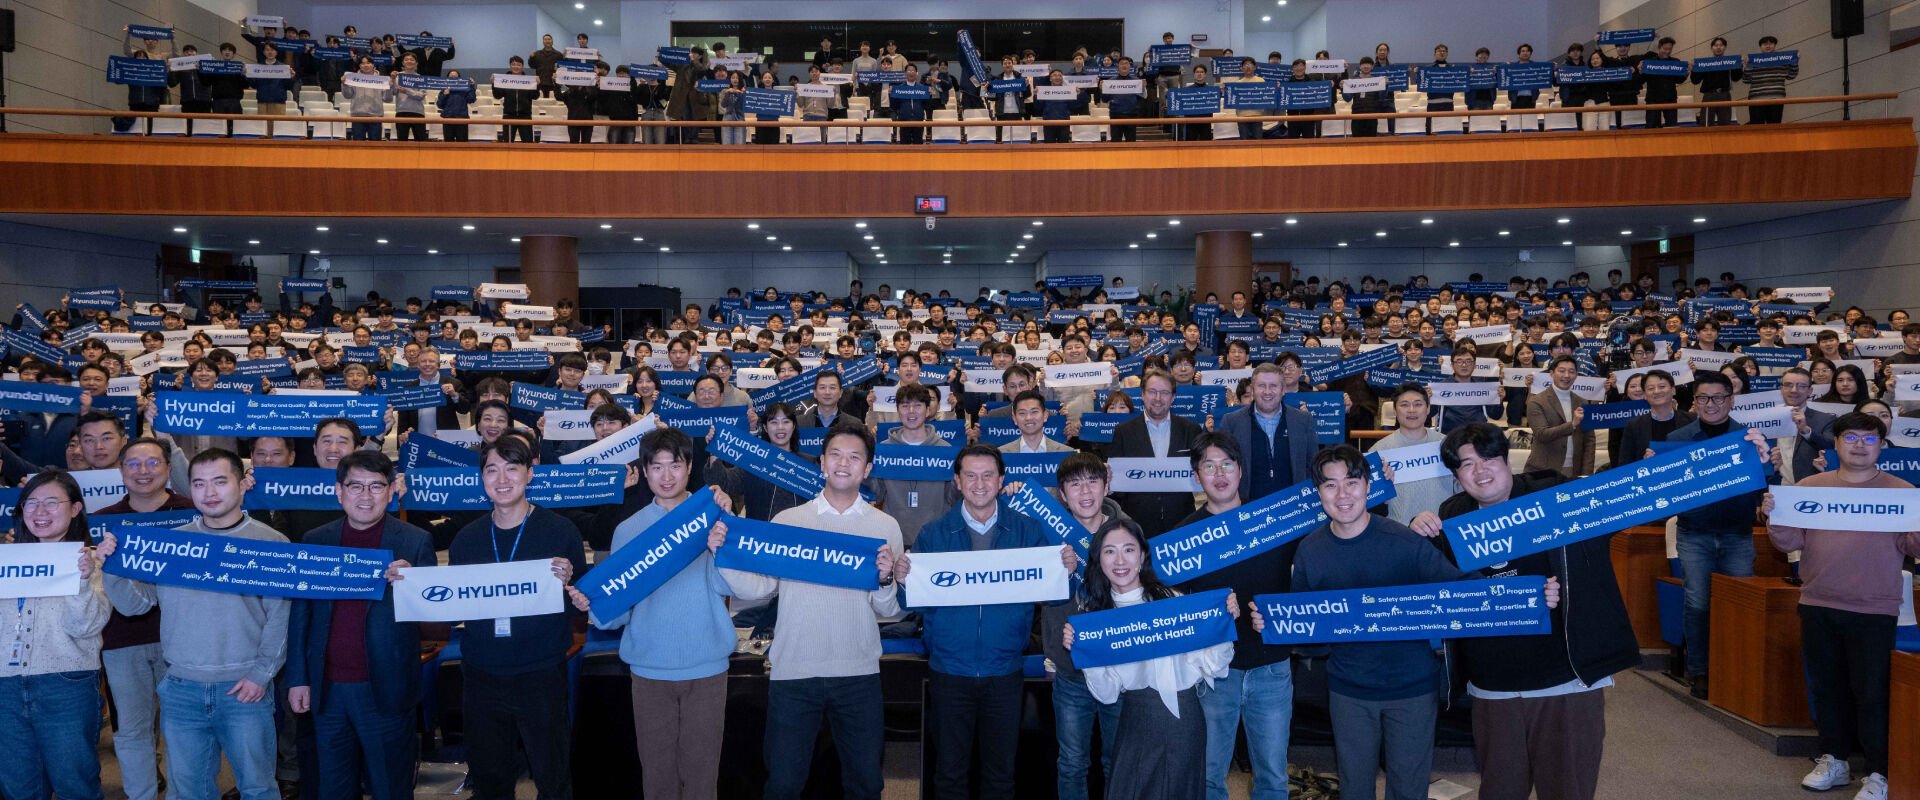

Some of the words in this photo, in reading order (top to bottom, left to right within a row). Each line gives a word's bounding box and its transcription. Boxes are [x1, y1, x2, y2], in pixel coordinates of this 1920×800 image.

[458, 354, 488, 362] Hyundai
[460, 360, 475, 368] Way
[1310, 365, 1339, 377] Hyundai
[1312, 374, 1329, 383] Way
[1371, 369, 1401, 379] Hyundai
[233, 381, 254, 390] Way
[1371, 376, 1388, 385] Way
[45, 392, 74, 406] Way
[517, 396, 538, 409] Way
[518, 386, 557, 403] Hyundai
[164, 398, 236, 414] Hyundai
[165, 414, 204, 430] Way
[668, 417, 713, 429] Hyundai
[1592, 408, 1632, 422] Hyundai
[717, 440, 742, 462] Way
[719, 428, 770, 460] Hyundai
[873, 455, 924, 469] Hyundai
[925, 457, 954, 470] Way
[1405, 454, 1440, 469] HYUN
[1573, 487, 1596, 499] Safety
[1595, 482, 1609, 492] and
[1609, 475, 1635, 488] Quality
[1651, 458, 1688, 475] Alignment
[1706, 443, 1739, 458] Progress
[264, 481, 336, 498] Hyunda
[410, 473, 479, 489] Hyundai
[412, 490, 449, 503] Way
[1562, 506, 1590, 520] Integrity
[1605, 493, 1635, 506] Tenacity
[1648, 478, 1683, 493] Resilience
[1698, 462, 1732, 478] Expertise
[1018, 482, 1074, 539] Hyundai
[1252, 508, 1269, 517] Safety
[1269, 503, 1281, 511] and
[1280, 494, 1300, 507] Quality
[1532, 534, 1552, 545] Agility
[1583, 514, 1624, 530] Data-Driven
[1624, 504, 1653, 518] Thinking
[1671, 490, 1702, 504] Diversity
[1702, 485, 1717, 495] and
[1717, 475, 1750, 490] Inclusion
[1827, 503, 1905, 515] HYUNDAI
[1243, 522, 1267, 536] Integrity
[1278, 509, 1301, 522] Tenacity
[1458, 501, 1546, 541] Hyundai
[124, 535, 210, 560] Hyundai
[1155, 521, 1231, 560] Hyundai
[1219, 550, 1237, 560] Agility
[1261, 529, 1293, 544] Data-Driven
[1292, 518, 1316, 532] Thinking
[1467, 535, 1513, 559] Way
[239, 549, 262, 558] Safety
[272, 553, 295, 562] Quality
[309, 555, 341, 563] Alignment
[600, 537, 673, 597] Hyundai
[668, 511, 709, 545] Way
[738, 535, 819, 561] Hyundai
[823, 549, 865, 571] Way
[121, 553, 167, 577] Way
[220, 561, 246, 570] Integrity
[260, 566, 287, 575] Tenacity
[1161, 553, 1203, 577] Way
[181, 572, 202, 581] Agility
[231, 578, 268, 587] Data-Driven
[269, 582, 295, 590] Thinking
[310, 584, 337, 592] Diversity
[965, 567, 1043, 584] HYUNDAI
[458, 582, 538, 599] HYUNDAI
[1378, 597, 1398, 605] Safety
[1412, 593, 1436, 602] Quality
[1452, 590, 1487, 599] Alignment
[1506, 587, 1537, 596] Progress
[1267, 598, 1349, 619] Hyundai
[1364, 611, 1390, 619] Integrity
[1406, 609, 1434, 617] Tenacity
[1495, 603, 1527, 612] Expertise
[1078, 630, 1104, 642] Stay
[1105, 622, 1151, 638] Humble,
[1152, 616, 1177, 630] Stay
[1179, 607, 1223, 625] Hungry,
[1272, 619, 1316, 637] Way
[1420, 623, 1448, 631] Thinking
[1465, 621, 1494, 629] Diversity
[1110, 638, 1131, 650] and
[1133, 632, 1163, 646] Work
[1164, 626, 1195, 641] Hard!
